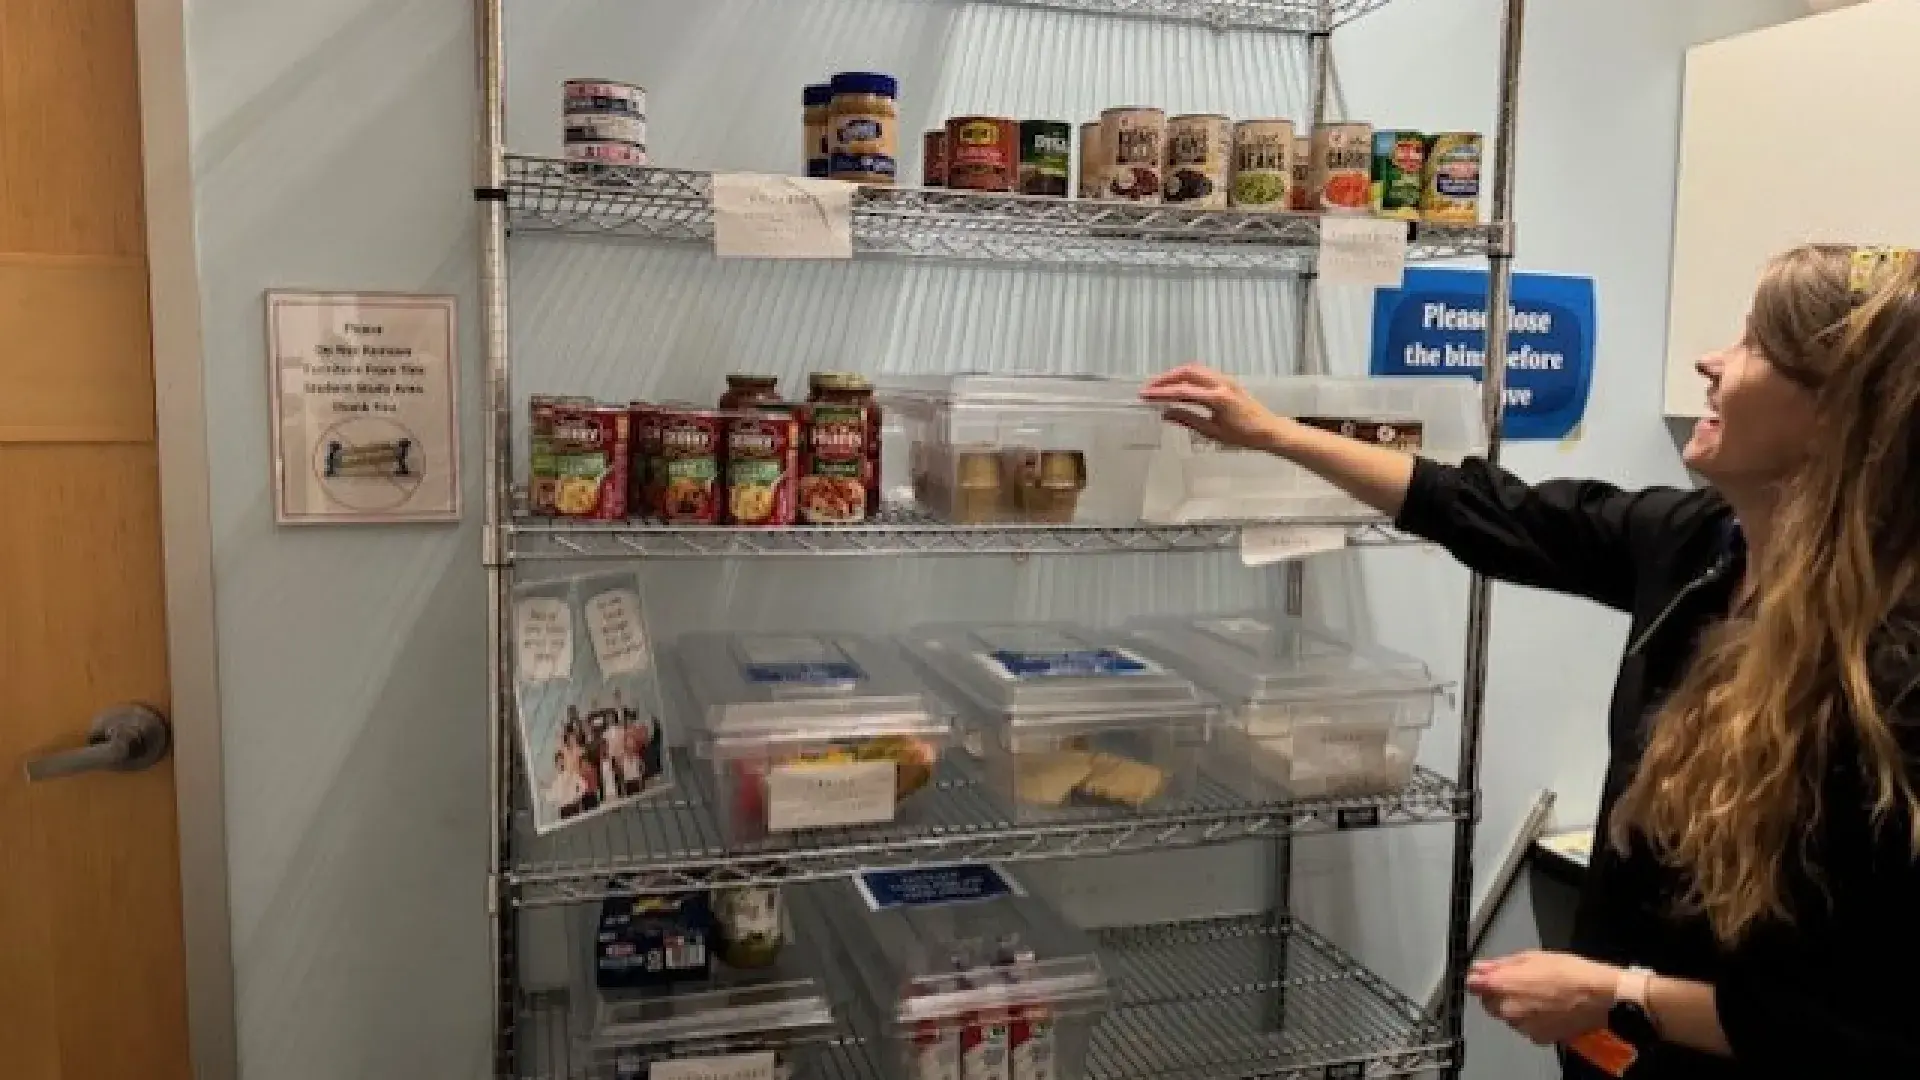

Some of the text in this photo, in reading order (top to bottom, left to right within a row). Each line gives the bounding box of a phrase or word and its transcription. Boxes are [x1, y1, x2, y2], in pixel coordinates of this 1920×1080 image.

[1507, 305, 1551, 333] lose
[1404, 341, 1440, 367] the
[1505, 343, 1564, 370] efore
